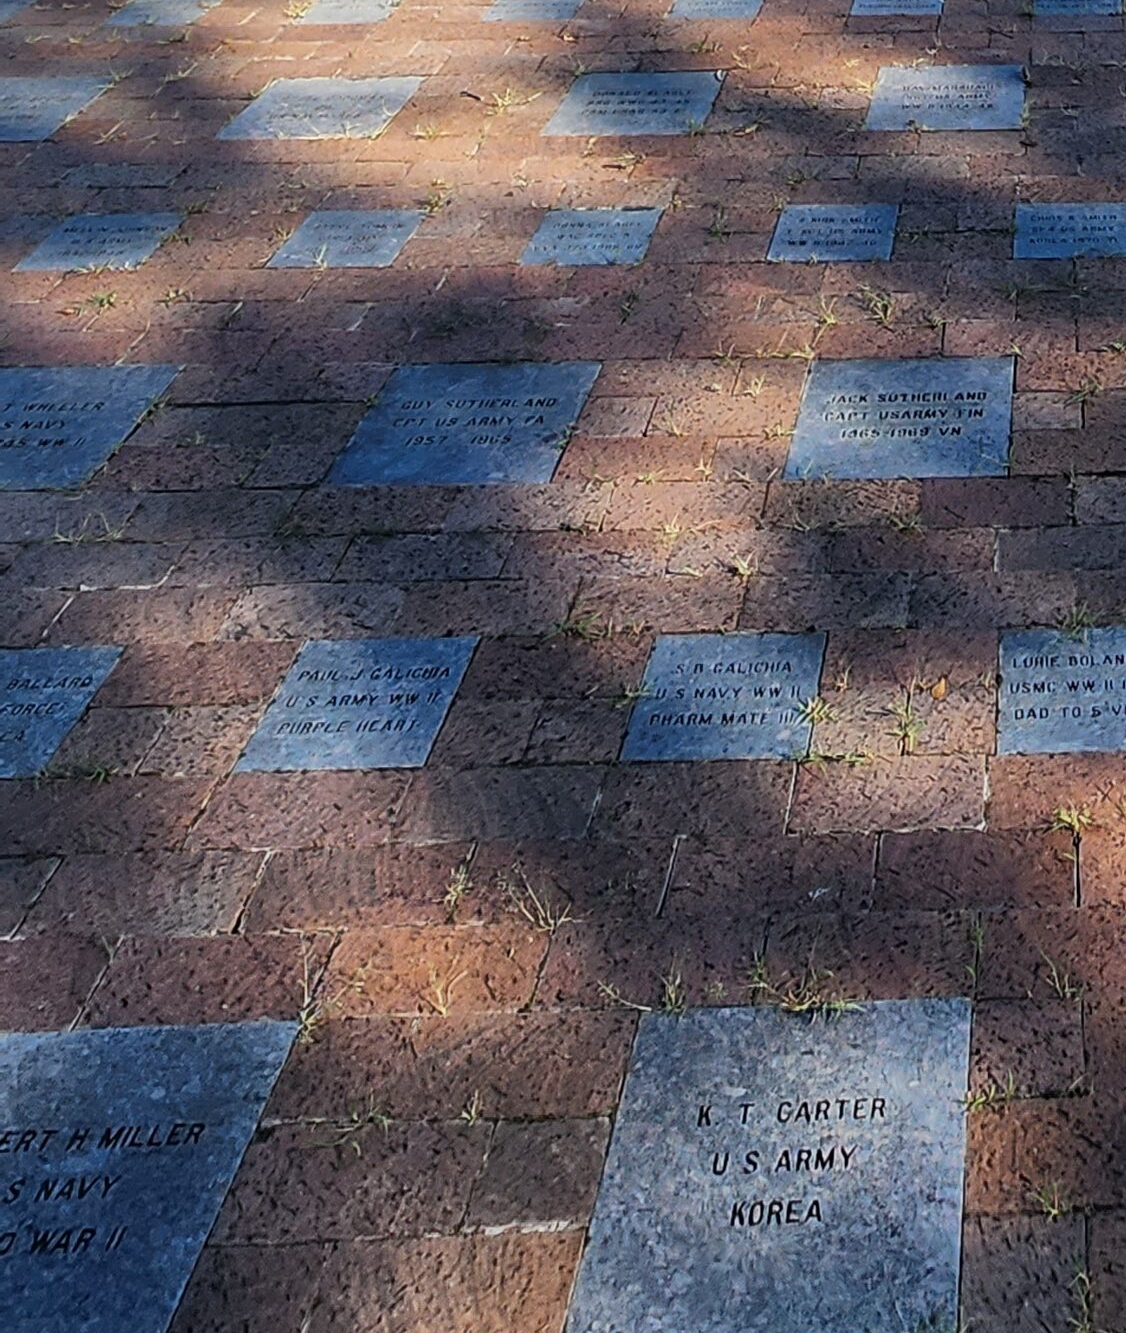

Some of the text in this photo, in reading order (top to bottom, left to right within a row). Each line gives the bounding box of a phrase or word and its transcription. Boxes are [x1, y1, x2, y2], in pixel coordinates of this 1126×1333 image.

[462, 416, 516, 428] ARMY
[713, 661, 792, 675] GALICHIA
[6, 674, 94, 690] BALLARD
[1010, 680, 1095, 694] USMC WW
[326, 691, 442, 707] ARMY WW II
[694, 686, 783, 699] NAVY WW
[650, 712, 768, 726] PHARM MATE
[1014, 707, 1049, 720] DAD
[1062, 706, 1082, 718] TO
[278, 718, 417, 735] PURPLE HEART
[66, 1123, 206, 1152] H MILLER
[712, 1146, 857, 1176] U S ARMY
[2, 1175, 122, 1204] S NAVY
[730, 1200, 823, 1227] KOREA
[31, 1226, 97, 1254] WAR
[105, 1225, 128, 1252] II
